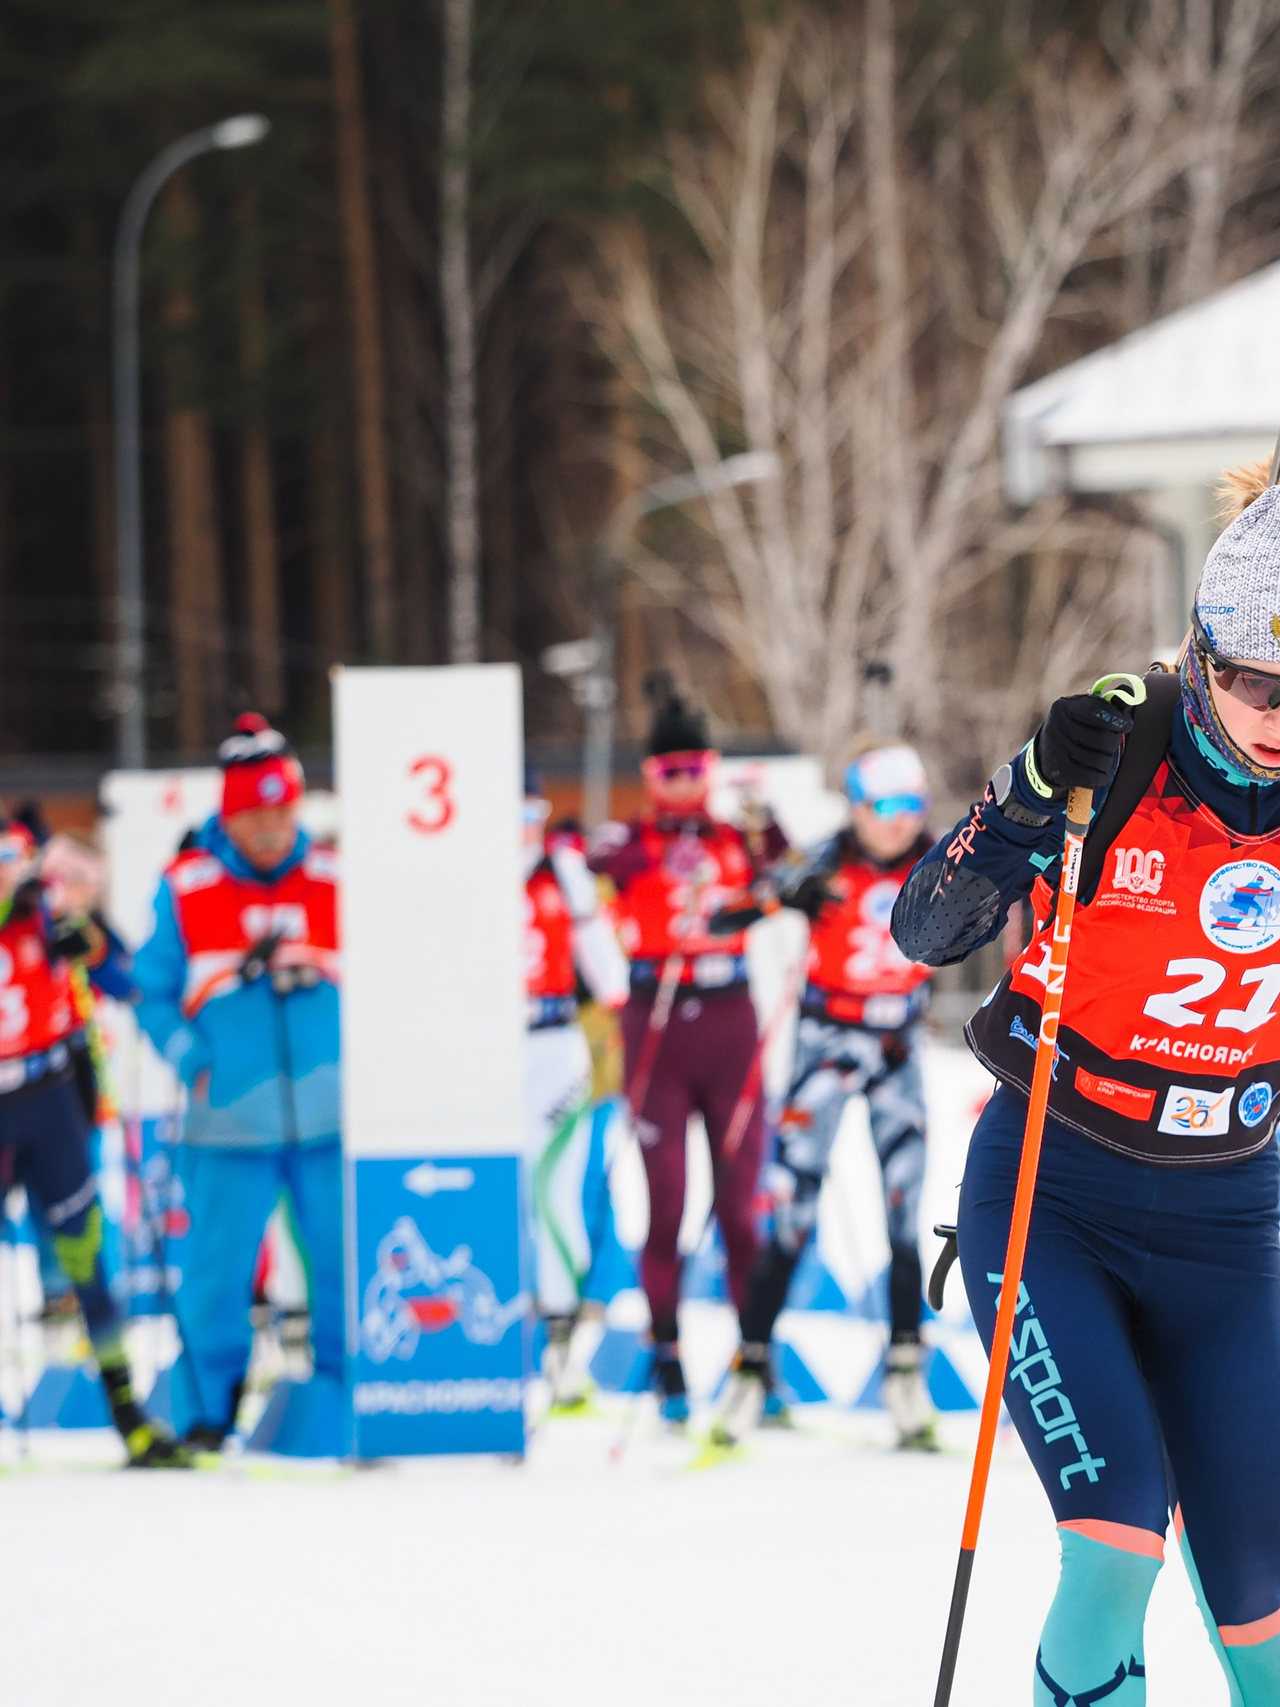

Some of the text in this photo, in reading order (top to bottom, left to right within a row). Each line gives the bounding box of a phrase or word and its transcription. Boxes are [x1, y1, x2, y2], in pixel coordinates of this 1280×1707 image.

[405, 754, 456, 835] 3
[1208, 862, 1258, 888] ПЕРВЕНСТВО
[1096, 899, 1178, 916] РОССИЙСКОЙ ФЕДЕРАЦИИ
[1101, 893, 1176, 908] МИНИСТЕРСТВО СПОРТА
[1130, 1034, 1257, 1065] КРАСНОЯРС
